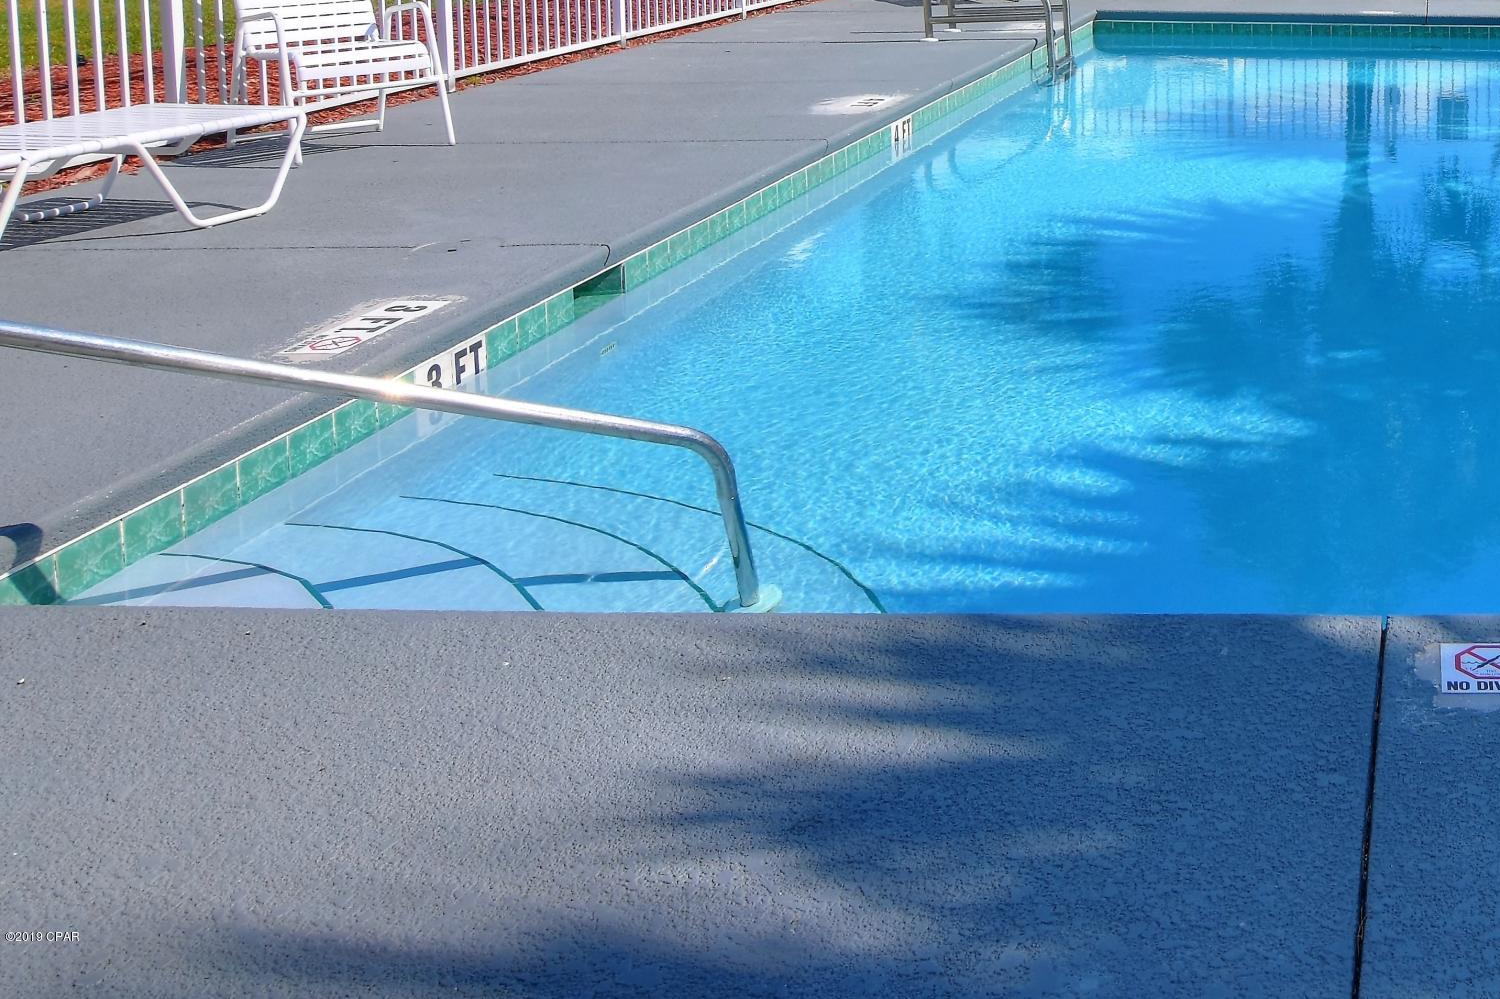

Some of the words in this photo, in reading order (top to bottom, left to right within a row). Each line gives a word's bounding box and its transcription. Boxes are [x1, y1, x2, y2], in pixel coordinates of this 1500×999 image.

[894, 124, 900, 142] 4
[427, 363, 443, 388] 3
[1447, 680, 1470, 691] NO
